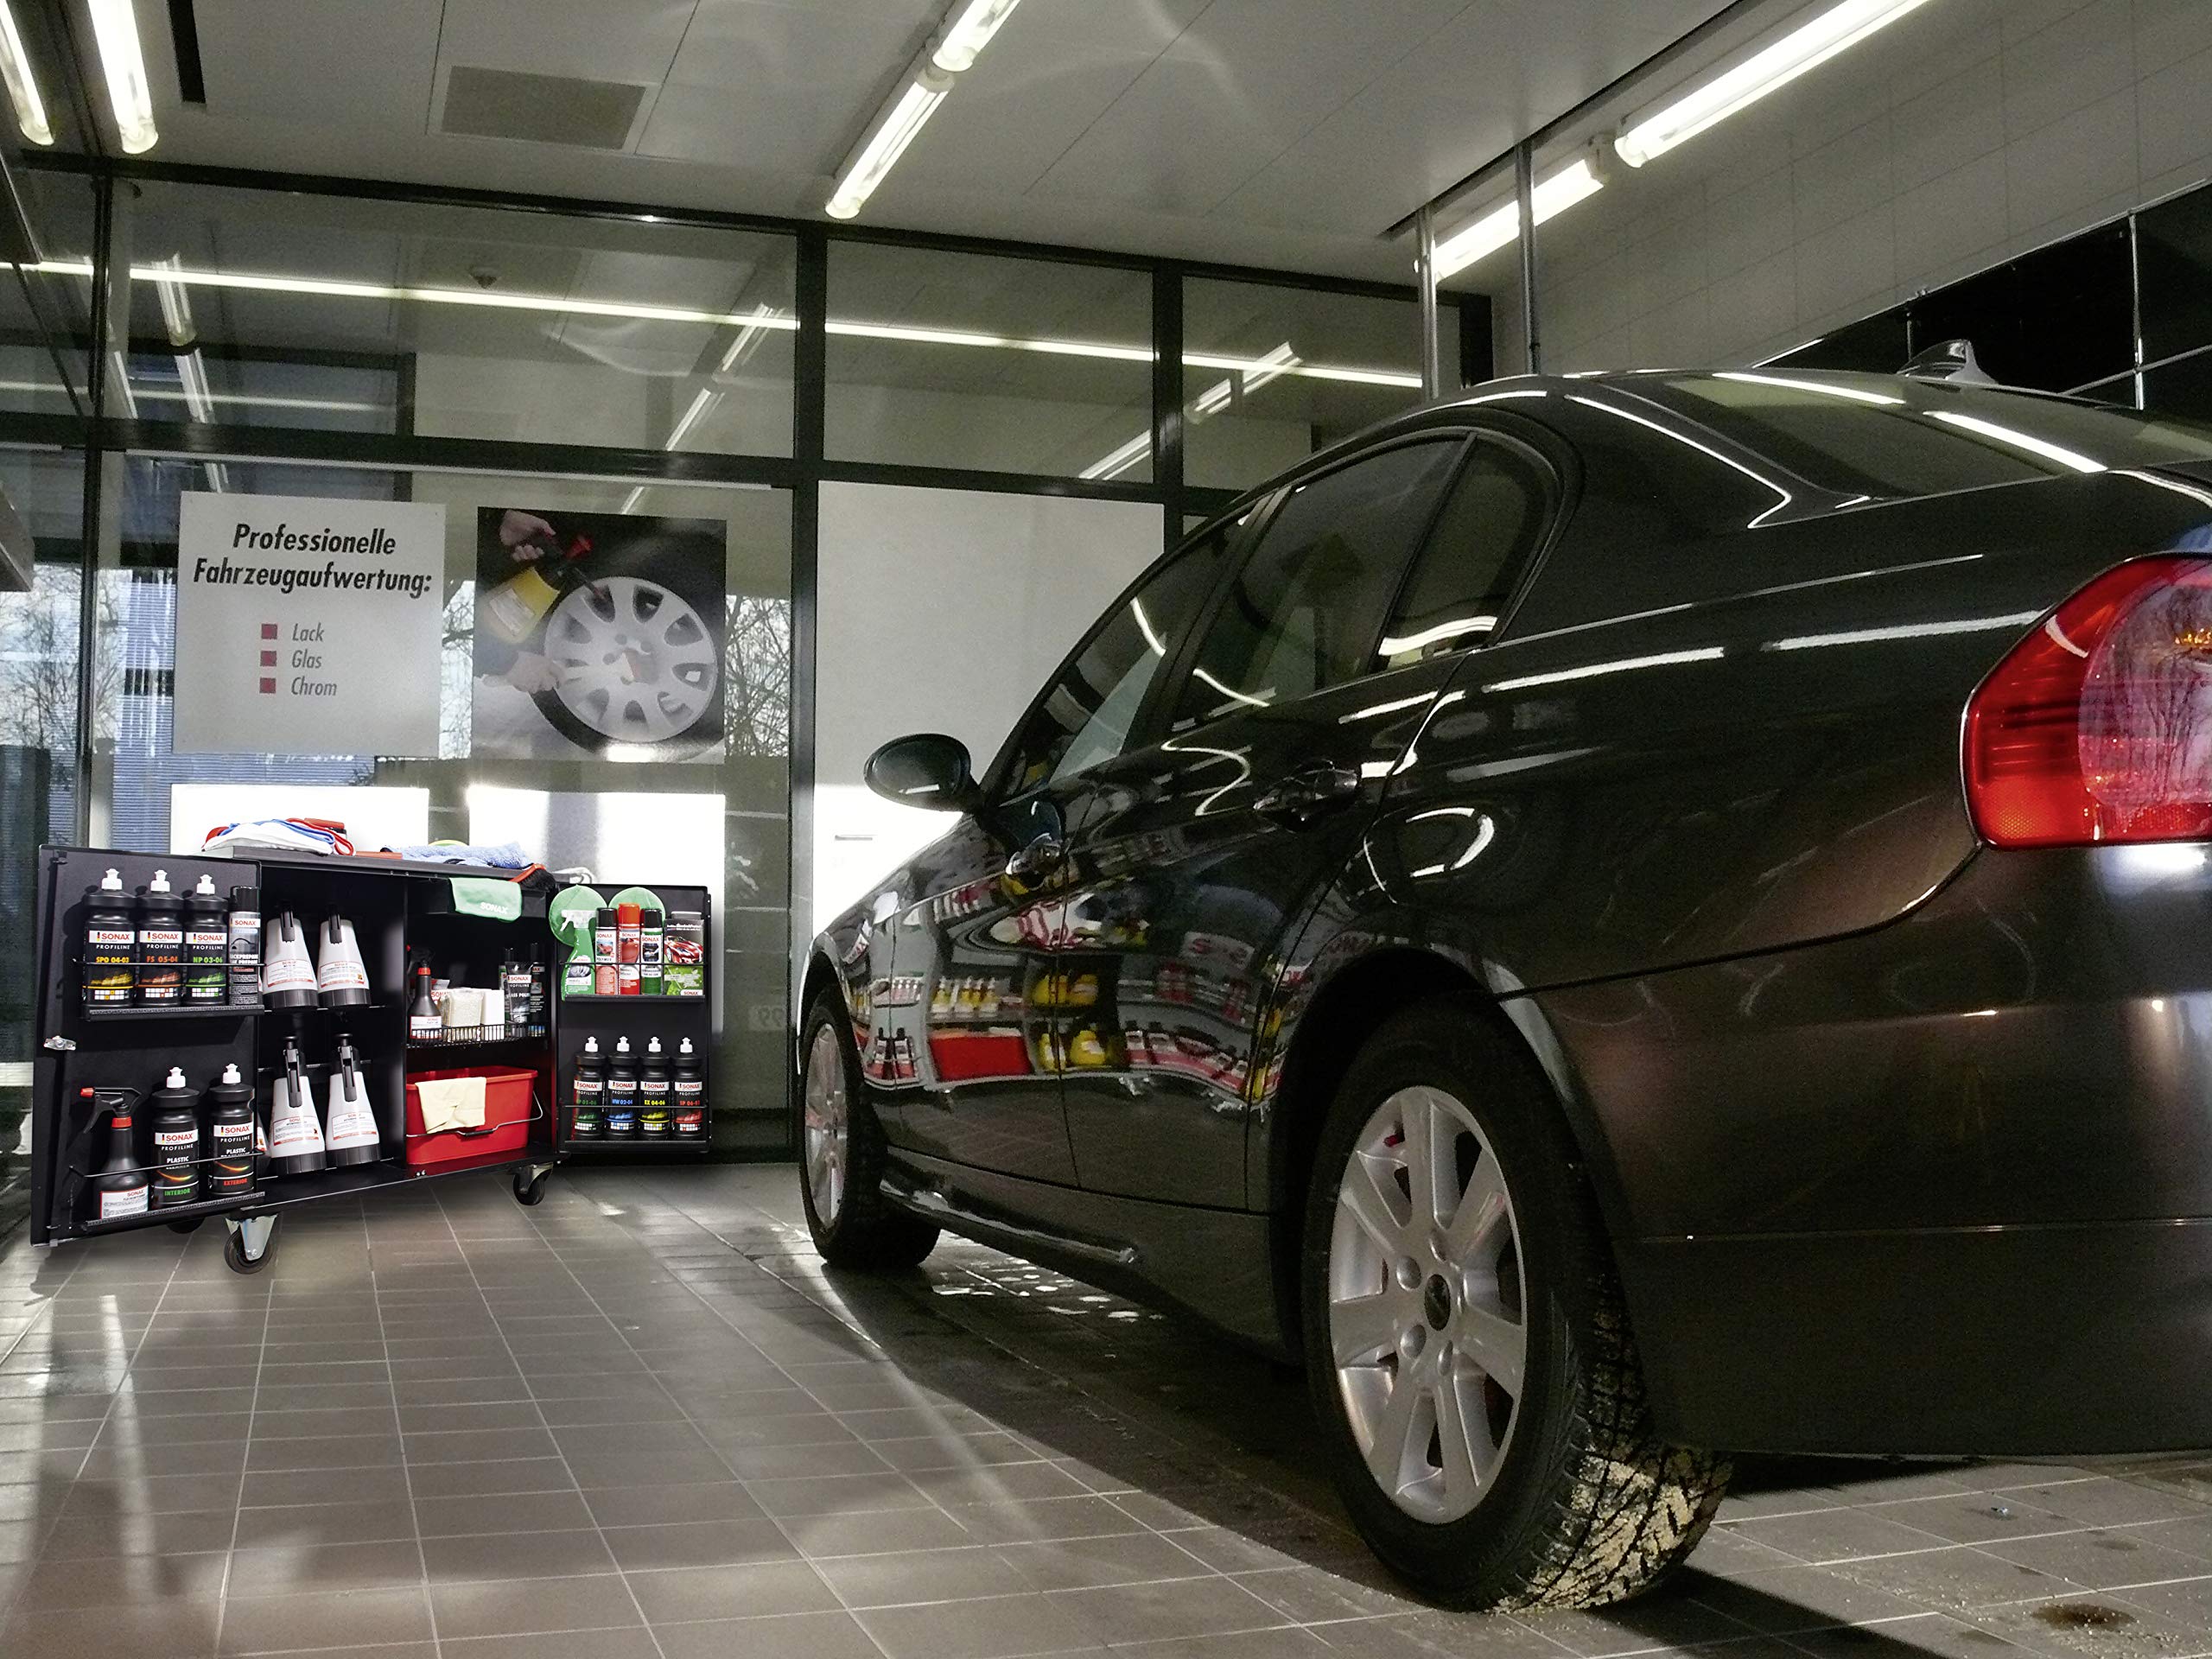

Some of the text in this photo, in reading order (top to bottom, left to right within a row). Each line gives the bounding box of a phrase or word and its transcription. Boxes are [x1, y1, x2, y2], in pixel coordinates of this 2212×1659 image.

[232, 523, 397, 555] Professionelle
[193, 557, 432, 600] Fahrzeugaufwertung:
[291, 622, 325, 642] Lack
[291, 650, 322, 670] Glas
[290, 677, 338, 696] Chrom
[480, 901, 508, 915] SONAX
[166, 1133, 194, 1141] SONAX
[225, 1125, 250, 1134] SONAX
[223, 1178, 248, 1186] EXTERIOR
